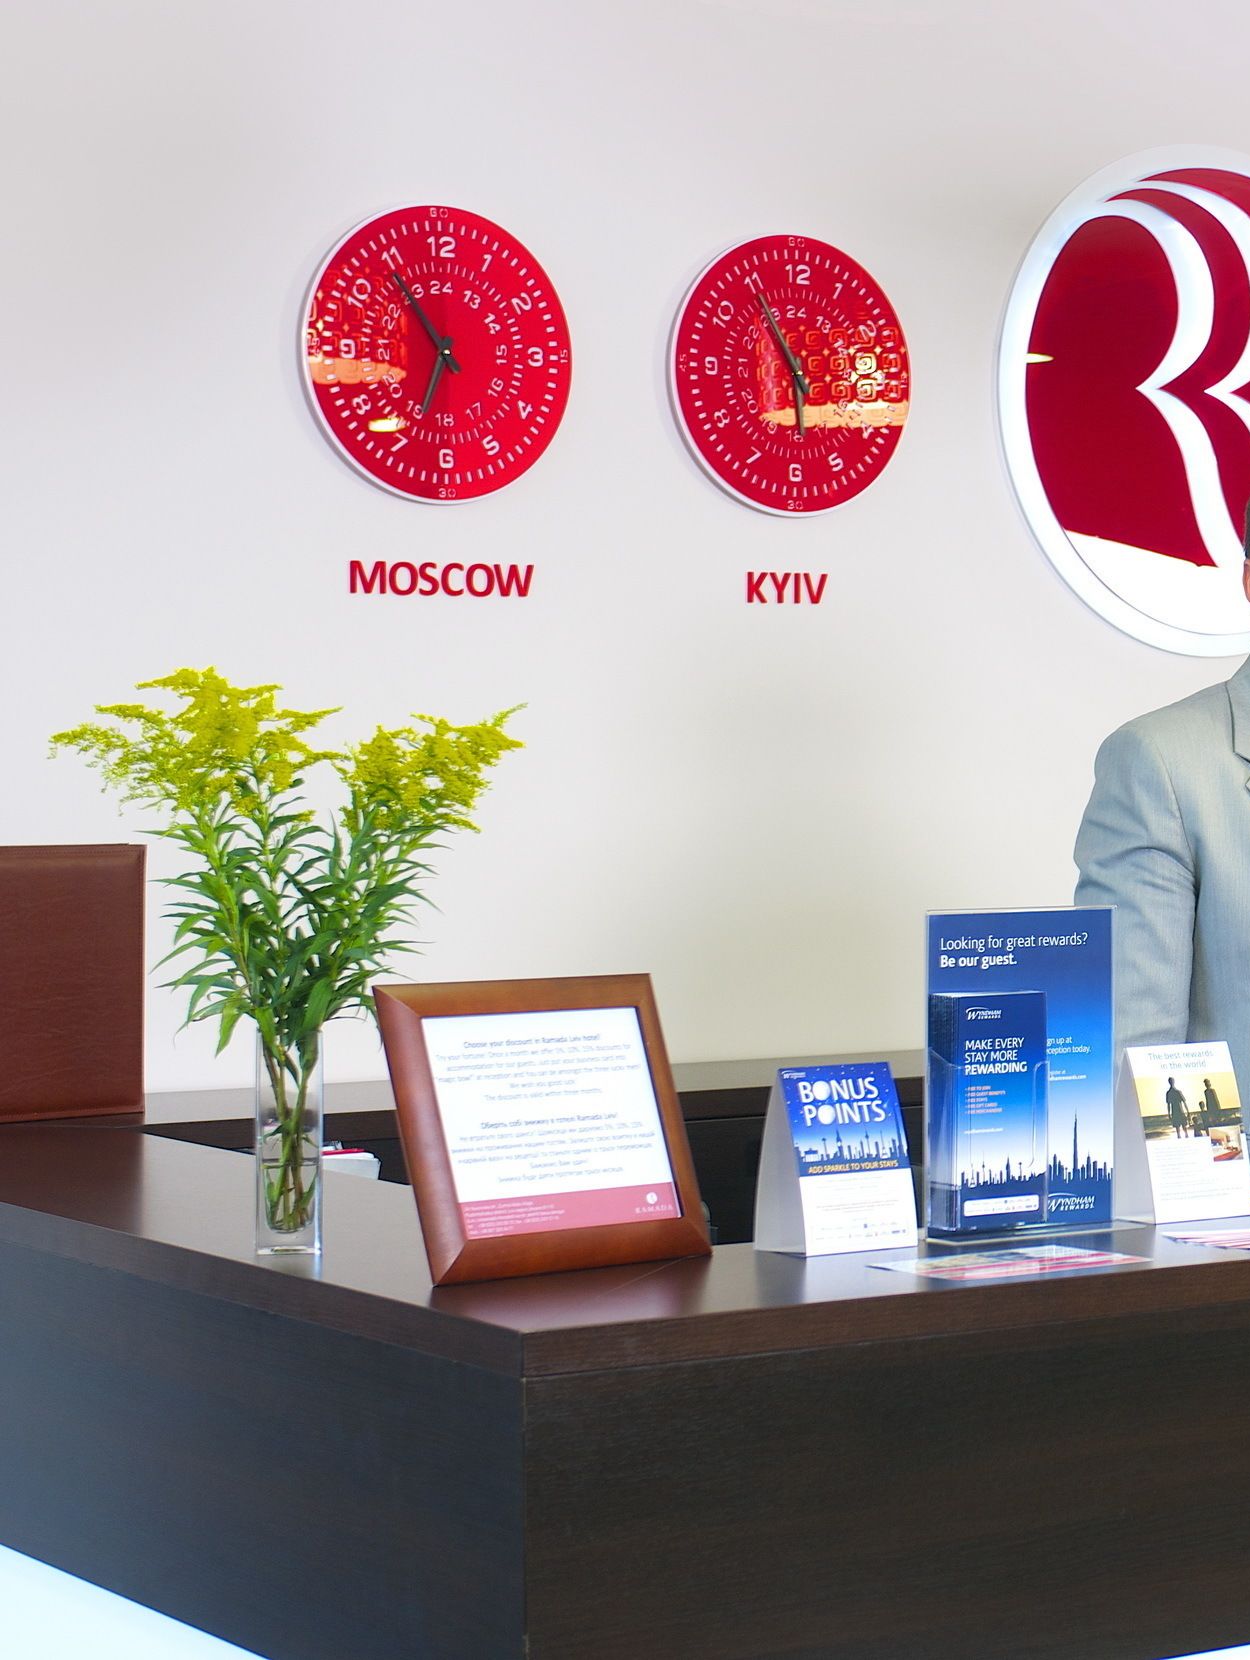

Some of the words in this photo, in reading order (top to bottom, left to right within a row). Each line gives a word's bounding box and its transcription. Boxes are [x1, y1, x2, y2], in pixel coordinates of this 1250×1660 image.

[427, 237, 456, 258] 12
[381, 246, 404, 269] 11
[482, 255, 493, 271] 1
[744, 273, 764, 293] 11
[785, 264, 810, 285] 12
[348, 280, 372, 308] 10
[834, 284, 842, 298] 1
[512, 292, 532, 315] 2
[713, 300, 734, 328] 10
[340, 339, 355, 357] 9
[528, 347, 543, 366] 3
[705, 357, 718, 375] 9
[352, 394, 372, 416] 8
[516, 400, 533, 420] 4
[714, 409, 730, 428] 8
[389, 433, 408, 452] 7
[483, 436, 500, 456] 5
[438, 448, 454, 468] 6
[746, 446, 762, 463] 7
[828, 453, 843, 471] 5
[790, 464, 801, 482] 6
[348, 559, 534, 597] MOSCOW
[746, 571, 828, 604] KYIV
[940, 937, 985, 952] Looking
[988, 935, 1004, 948] for
[1006, 935, 1036, 952] great
[1038, 932, 1088, 946] rewards?
[940, 955, 956, 968] Be
[958, 956, 979, 966] our
[981, 953, 1018, 969] guest.
[965, 1039, 993, 1050] MAKE
[995, 1037, 1024, 1049] EVERY
[1046, 1038, 1055, 1046] gn
[1056, 1037, 1064, 1045] up
[1046, 1046, 1071, 1056] eception
[1072, 1044, 1092, 1054] today.
[965, 1052, 988, 1063] STAY
[990, 1050, 1018, 1061] MORE
[1148, 1052, 1162, 1060] The
[1164, 1052, 1181, 1060] best
[1182, 1050, 1214, 1058] rewards
[1184, 1060, 1206, 1068] world
[965, 1061, 1027, 1076] REWARDING
[798, 1077, 879, 1103] BONUS
[803, 1100, 886, 1126] POINTS
[808, 1166, 822, 1174] ADD
[824, 1164, 850, 1172] SPARKLE
[862, 1162, 878, 1170] YOUR
[880, 1160, 898, 1168] STAYS
